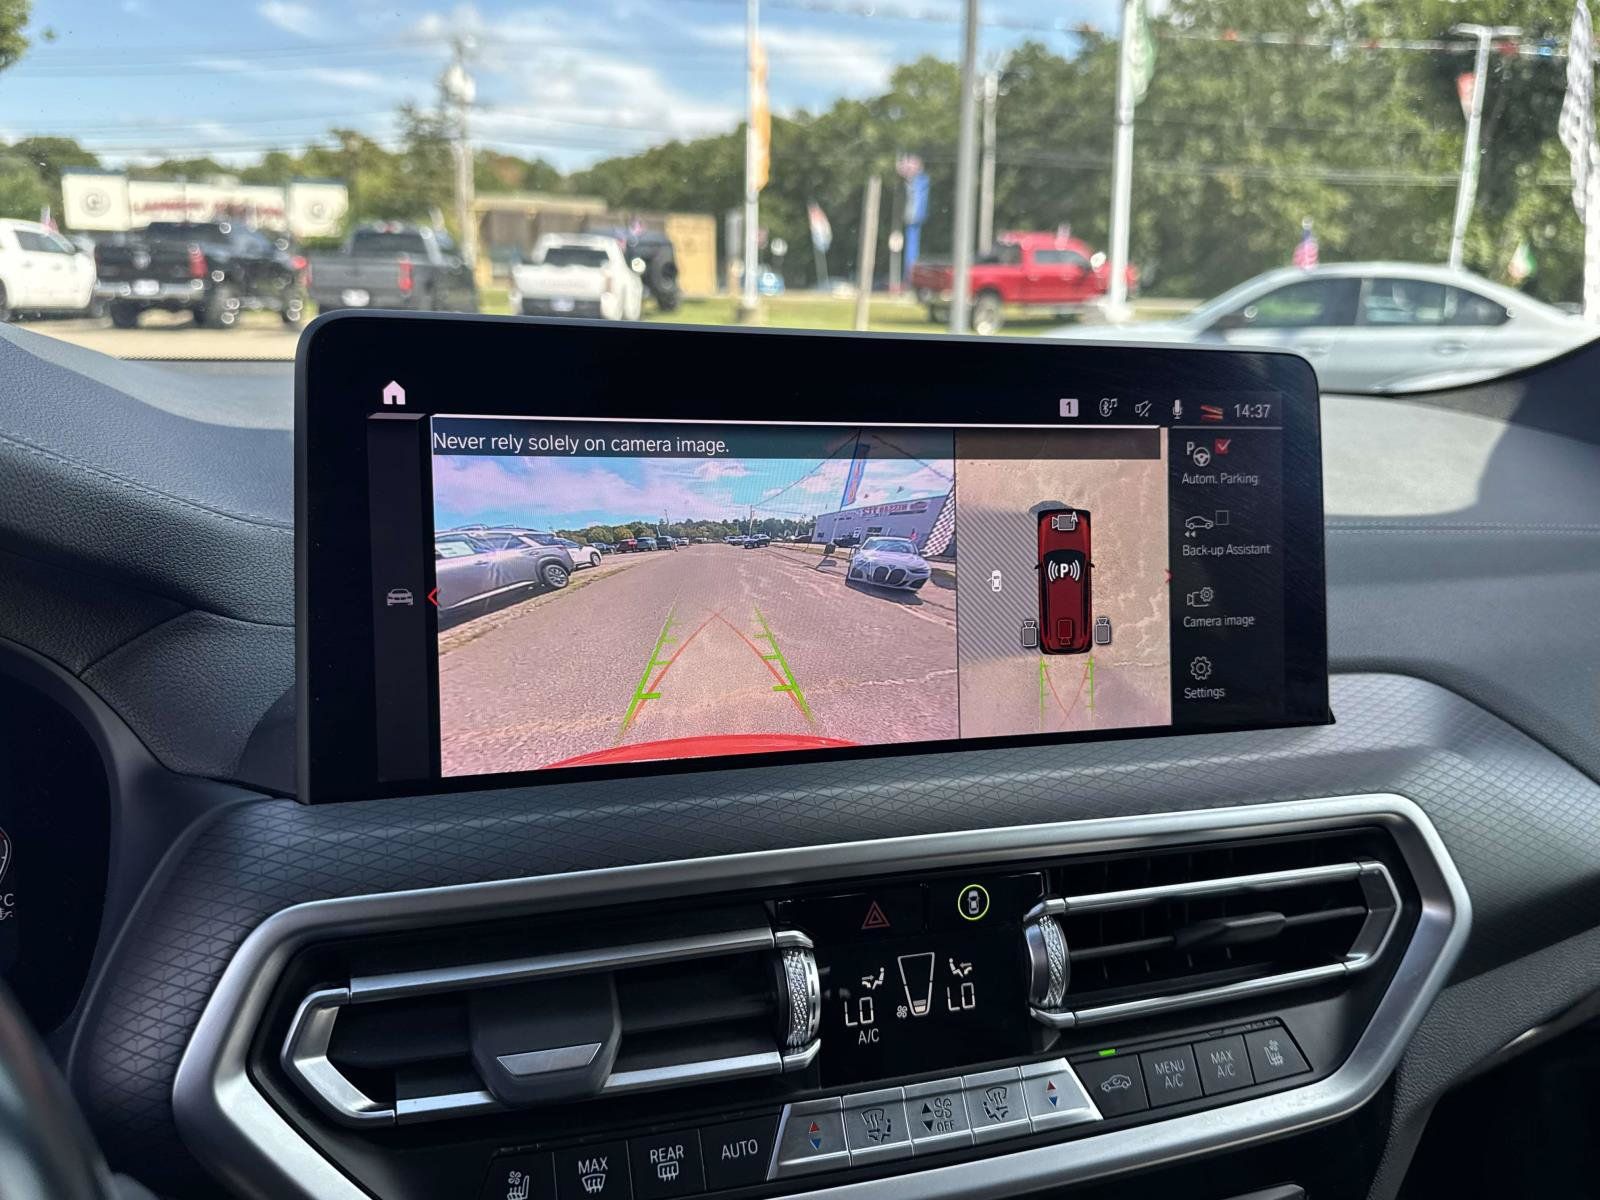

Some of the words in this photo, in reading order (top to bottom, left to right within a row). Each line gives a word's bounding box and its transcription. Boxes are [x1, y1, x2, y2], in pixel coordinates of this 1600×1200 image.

[1233, 403, 1271, 418] 14:37
[433, 432, 484, 449] Never
[491, 433, 523, 453] rely
[528, 434, 579, 454] solely
[584, 438, 606, 451] on
[611, 438, 672, 452] camera
[676, 436, 730, 456] image.
[1181, 472, 1218, 485] Autom.
[1220, 472, 1259, 486] Parking
[1182, 543, 1224, 557] Back-up
[1226, 543, 1272, 556] Assistant
[1183, 615, 1222, 628] Camera
[1224, 614, 1255, 629] image
[1184, 686, 1225, 701] Settings
[858, 1027, 880, 1045] A/C
[1210, 1050, 1234, 1065] MAX
[1154, 1058, 1185, 1075] MENU
[1217, 1063, 1235, 1078] A/C
[1165, 1073, 1184, 1089] A/C
[650, 1144, 684, 1164] REAR
[721, 1139, 758, 1160] AUTO
[578, 1157, 608, 1175] MAX
